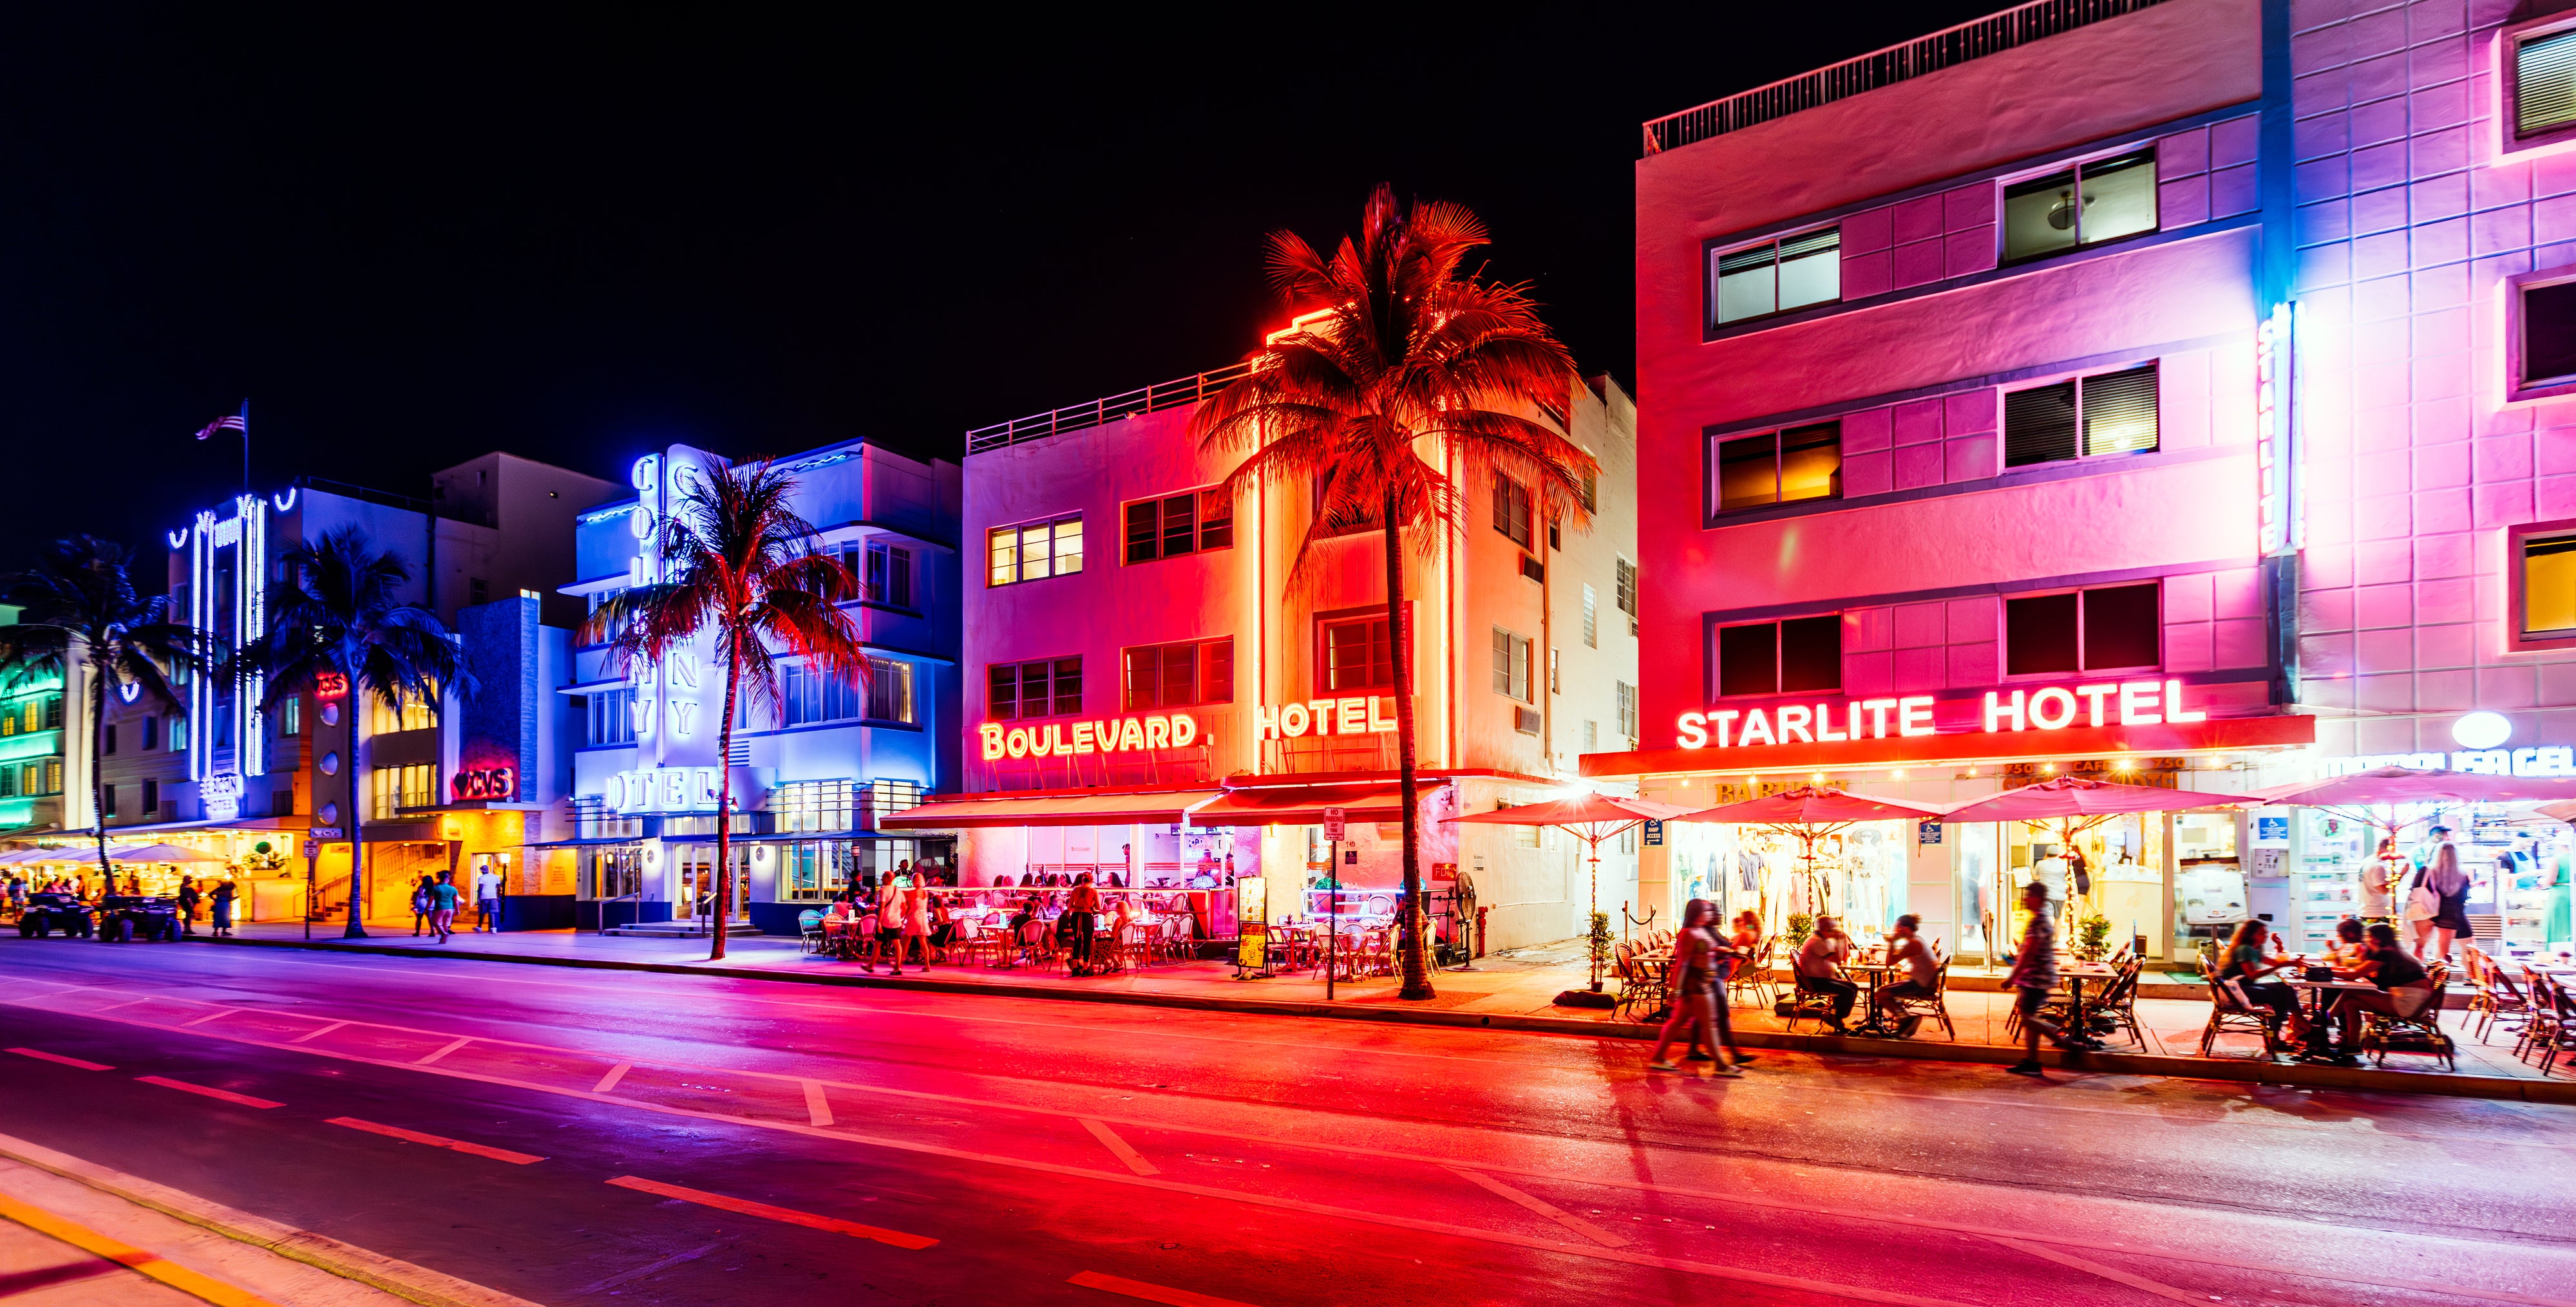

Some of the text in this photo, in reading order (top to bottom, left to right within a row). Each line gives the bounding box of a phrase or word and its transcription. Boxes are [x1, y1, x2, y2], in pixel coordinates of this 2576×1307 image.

[630, 457, 656, 733] COLNY
[981, 696, 1397, 760] BOULEVARD HOTEL
[1677, 680, 2206, 749] STARLITE HOTEL
[471, 767, 514, 797] CVS
[607, 772, 719, 809] OTEL
